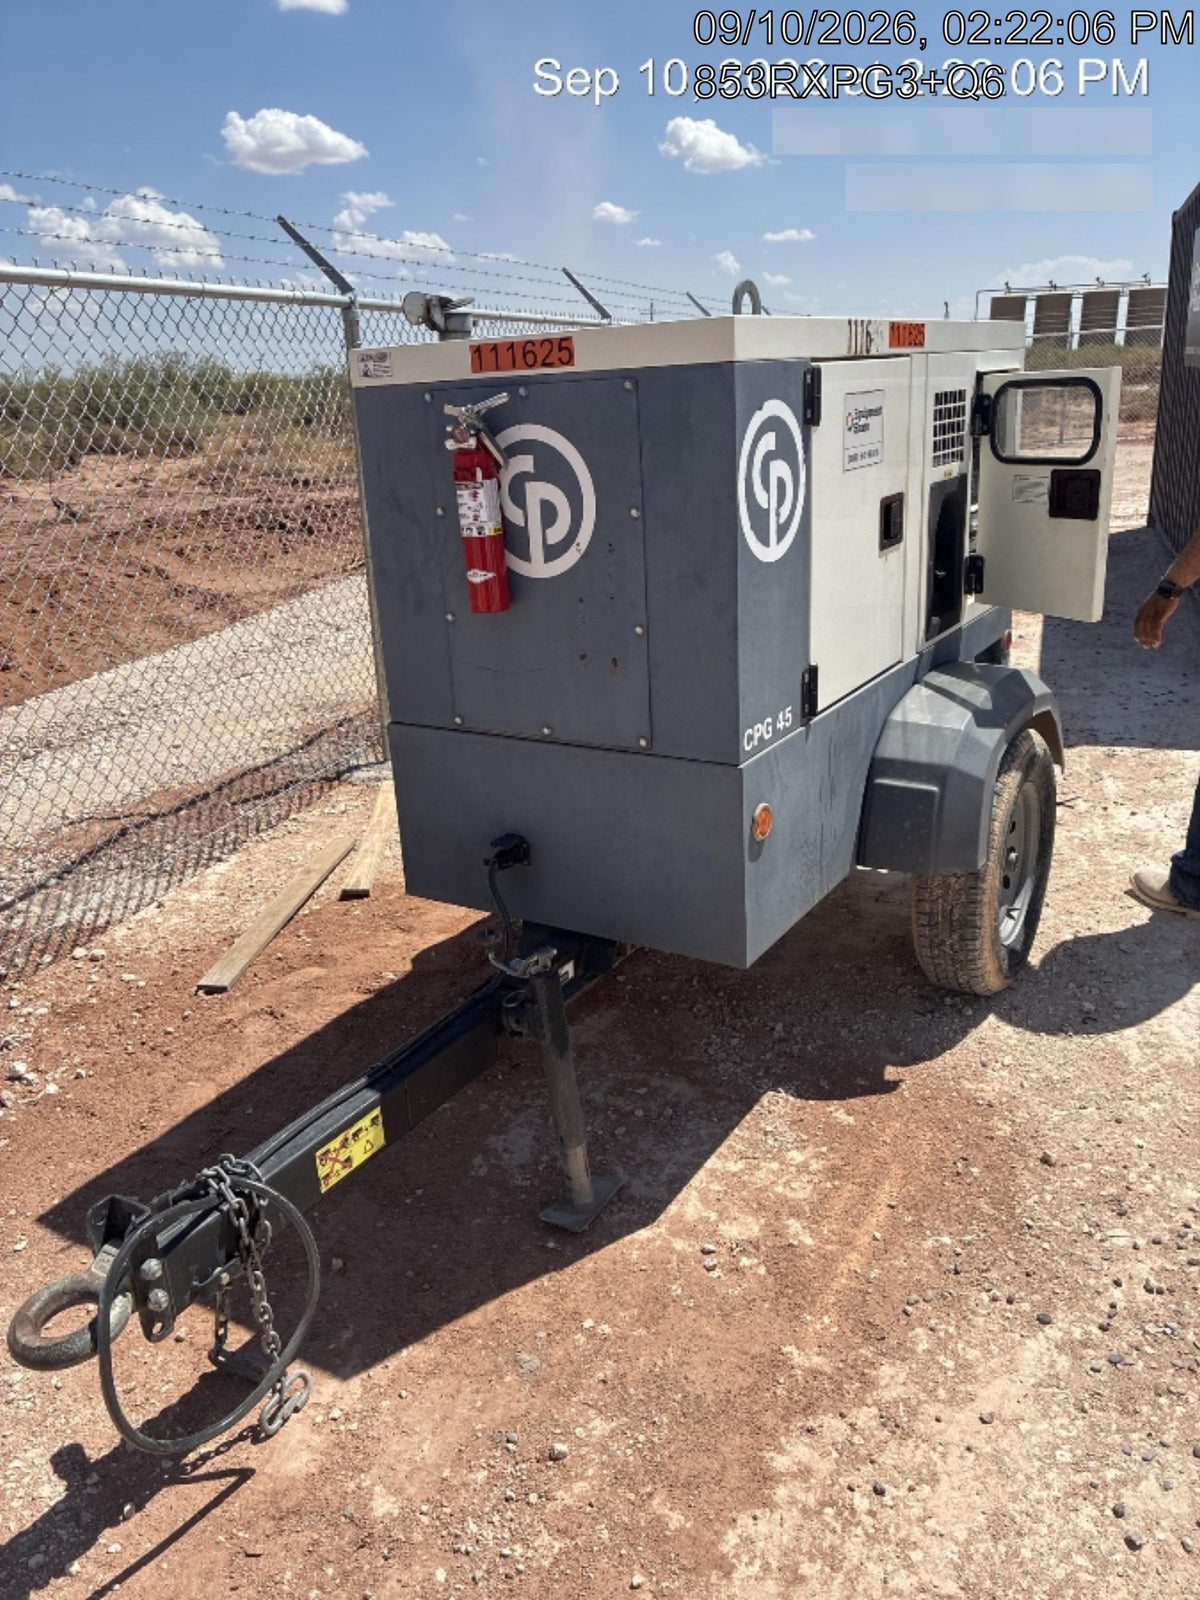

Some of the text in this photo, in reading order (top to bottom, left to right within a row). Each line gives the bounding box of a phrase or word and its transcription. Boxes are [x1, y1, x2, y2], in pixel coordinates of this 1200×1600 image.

[474, 336, 573, 371] 111625
[743, 705, 792, 751] CPG 45
